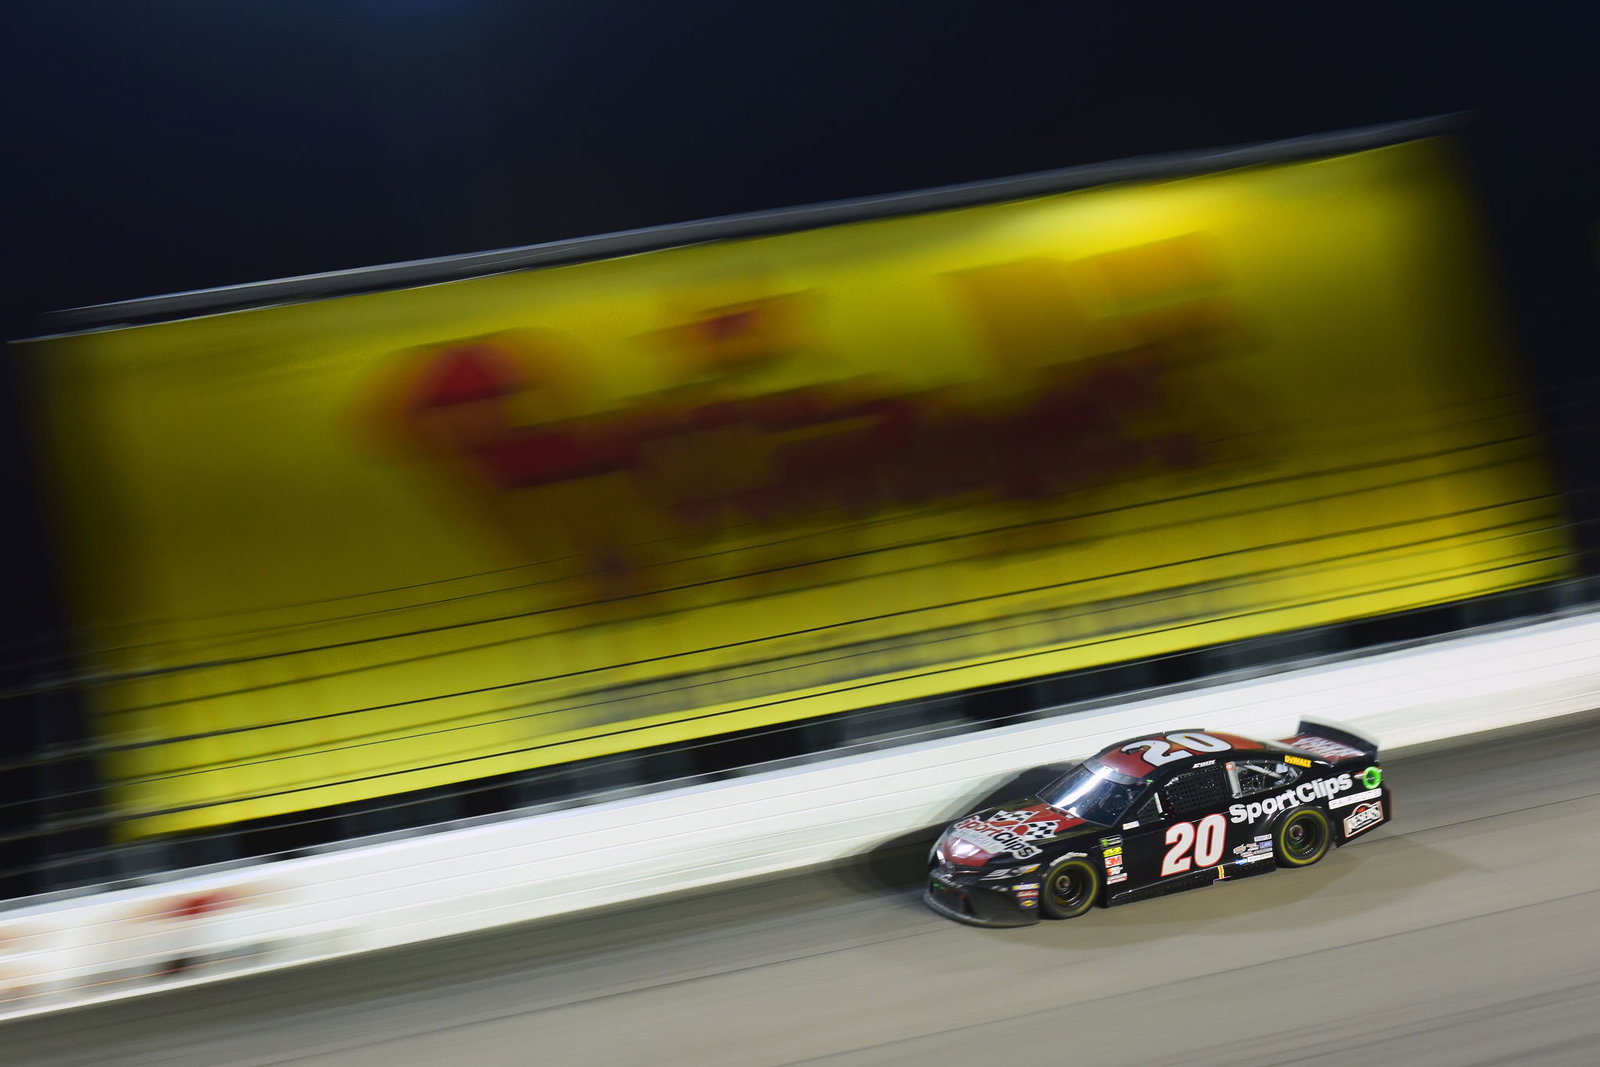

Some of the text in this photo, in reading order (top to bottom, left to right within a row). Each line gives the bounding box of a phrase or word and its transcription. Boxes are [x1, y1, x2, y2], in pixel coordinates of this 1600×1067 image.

[1120, 732, 1232, 767] 20
[1229, 773, 1353, 824] SportClips
[1160, 813, 1227, 877] 20
